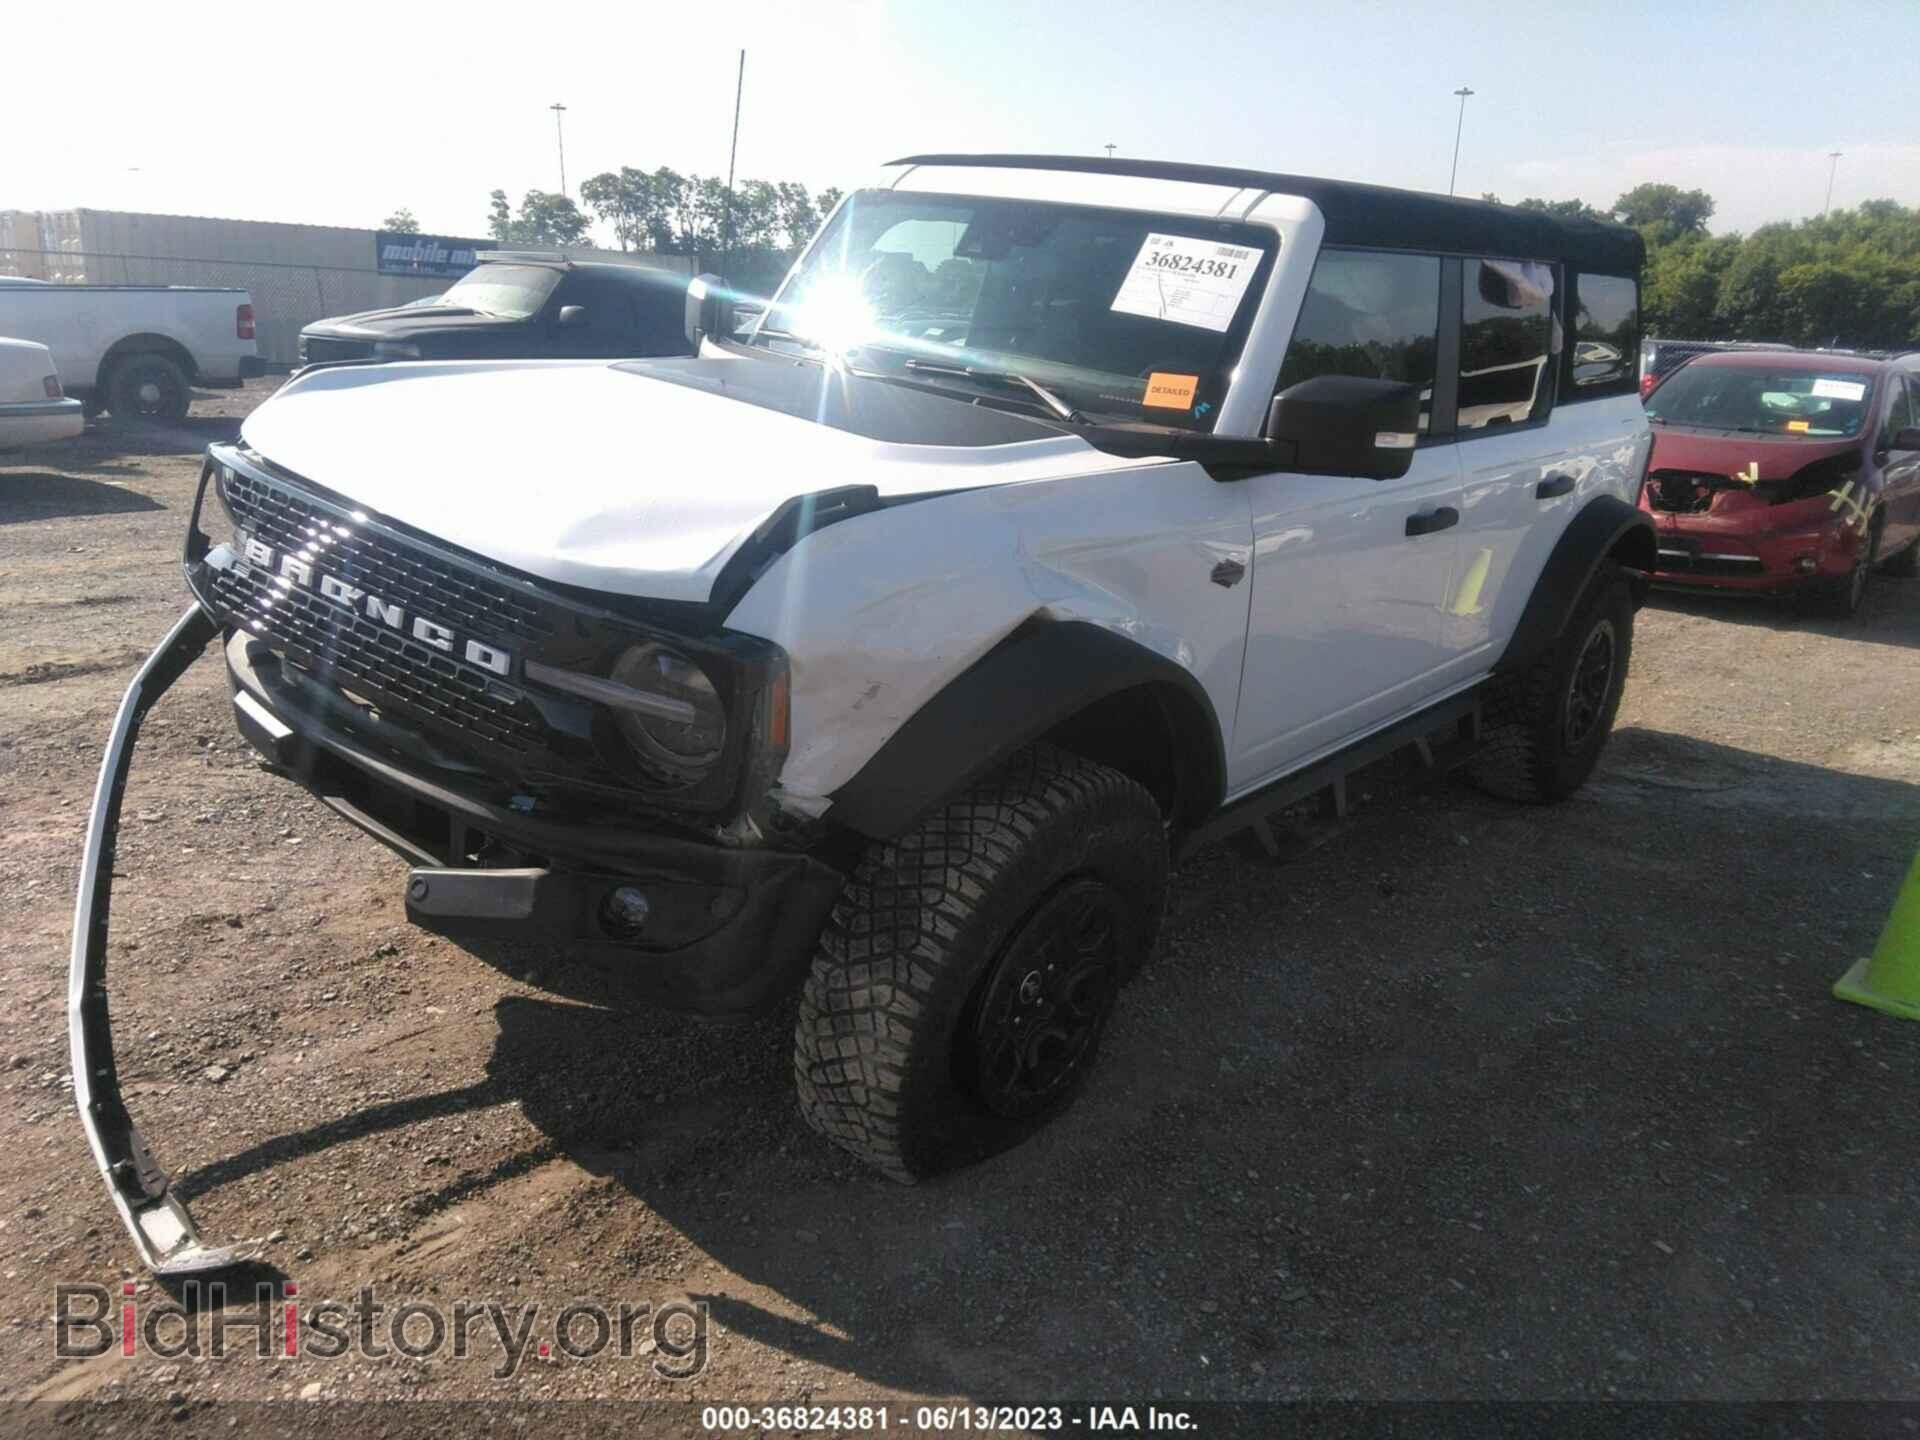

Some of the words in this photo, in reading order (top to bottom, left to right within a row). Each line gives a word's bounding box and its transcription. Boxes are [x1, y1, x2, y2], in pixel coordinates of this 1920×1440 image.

[383, 240, 448, 263] mobile
[1146, 251, 1238, 279] 36824381
[1151, 386, 1190, 396] DETAILED
[245, 538, 511, 675] BRONCO
